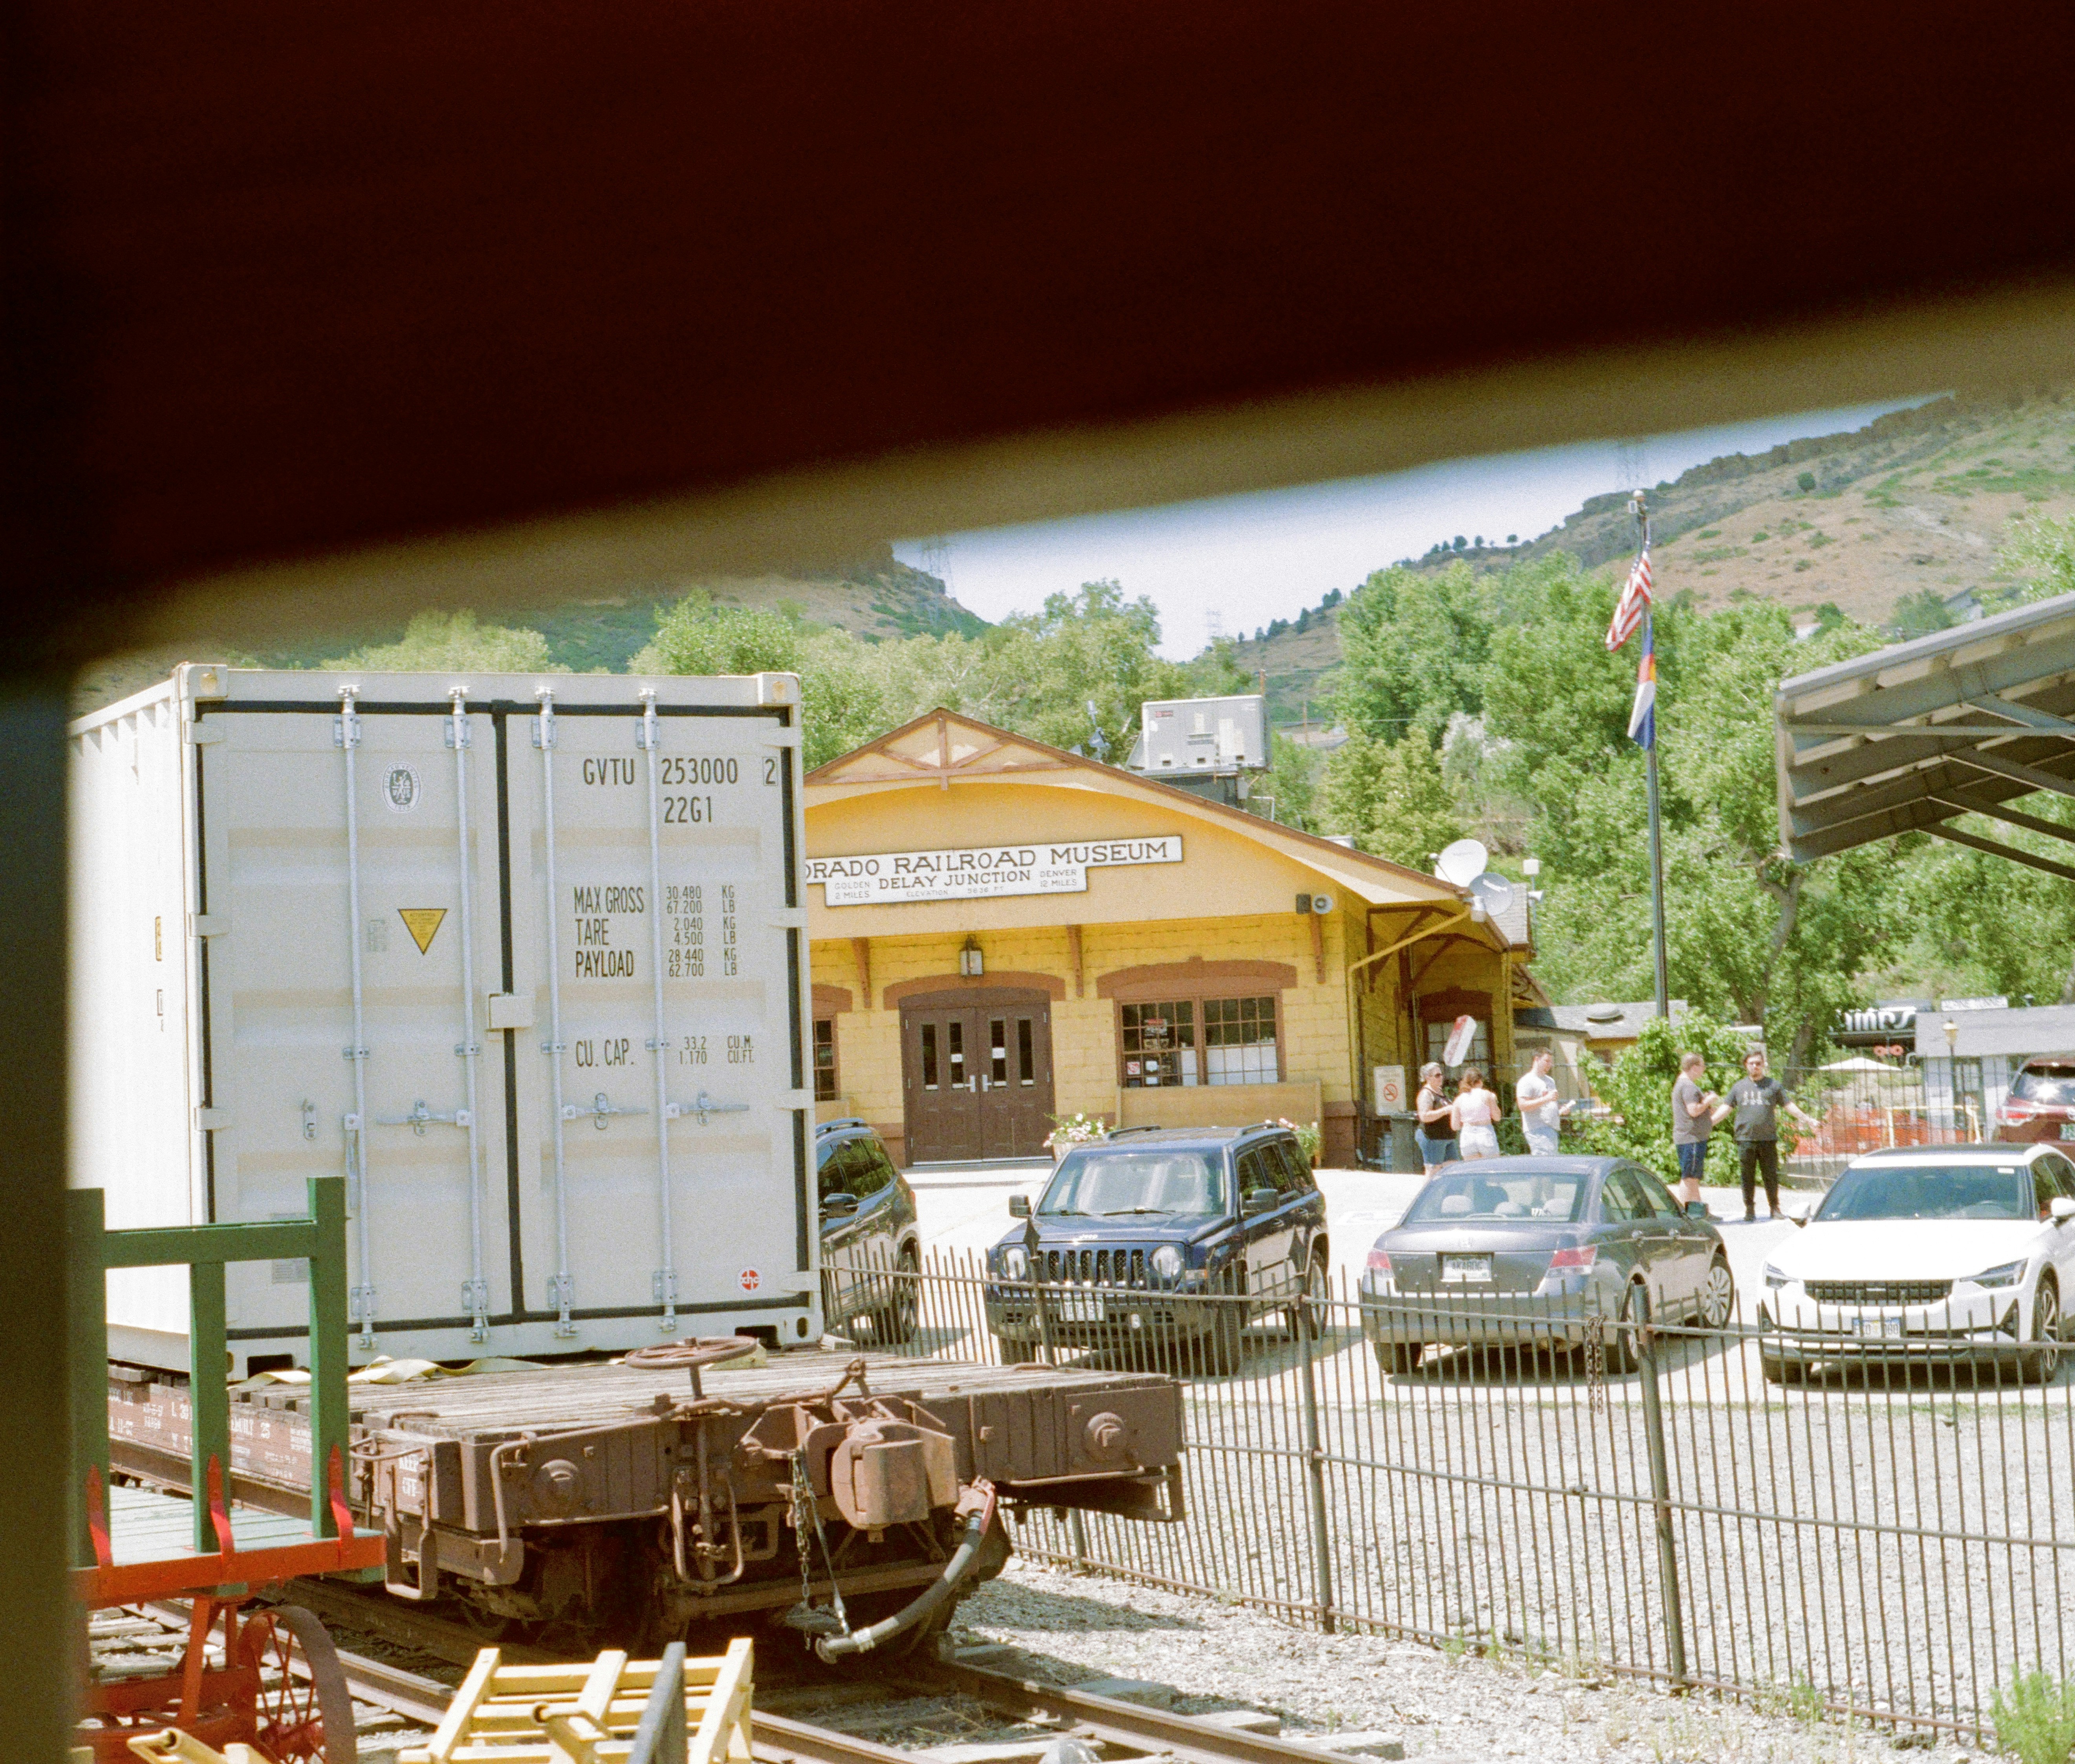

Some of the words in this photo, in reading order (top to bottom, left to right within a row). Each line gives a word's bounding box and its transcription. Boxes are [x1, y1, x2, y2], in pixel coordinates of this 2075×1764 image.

[583, 758, 635, 785] GVTU
[661, 758, 738, 784] 253000
[765, 758, 776, 784] 2
[664, 796, 711, 823] 22G1
[894, 850, 1036, 874] RAILROAD
[1051, 842, 1167, 866] MUSEUM
[879, 875, 937, 890] DELAY
[944, 869, 1031, 886] JUNCTION
[1040, 869, 1077, 878] DENVER
[835, 881, 870, 889] GOLDEN
[1051, 878, 1077, 887] MILES
[574, 886, 601, 913] MAX
[605, 886, 645, 913] GROSS
[667, 886, 701, 899] 30.480
[722, 885, 734, 898] KG
[667, 900, 702, 914] 67.200
[723, 900, 735, 913] LB
[674, 917, 703, 931] 2.040
[723, 916, 736, 930] KG
[575, 918, 610, 946] TARE
[674, 931, 703, 945] 4.500
[724, 931, 736, 944] LB
[668, 948, 704, 963] 28.440
[724, 948, 736, 961] KG
[576, 950, 634, 978] PAYLOAD
[669, 963, 704, 977] 62.700
[724, 962, 737, 975] LB
[684, 1036, 707, 1050] 33.2
[576, 1040, 599, 1067] CU.
[604, 1038, 634, 1066] CAP.
[679, 1050, 707, 1065] 1.170
